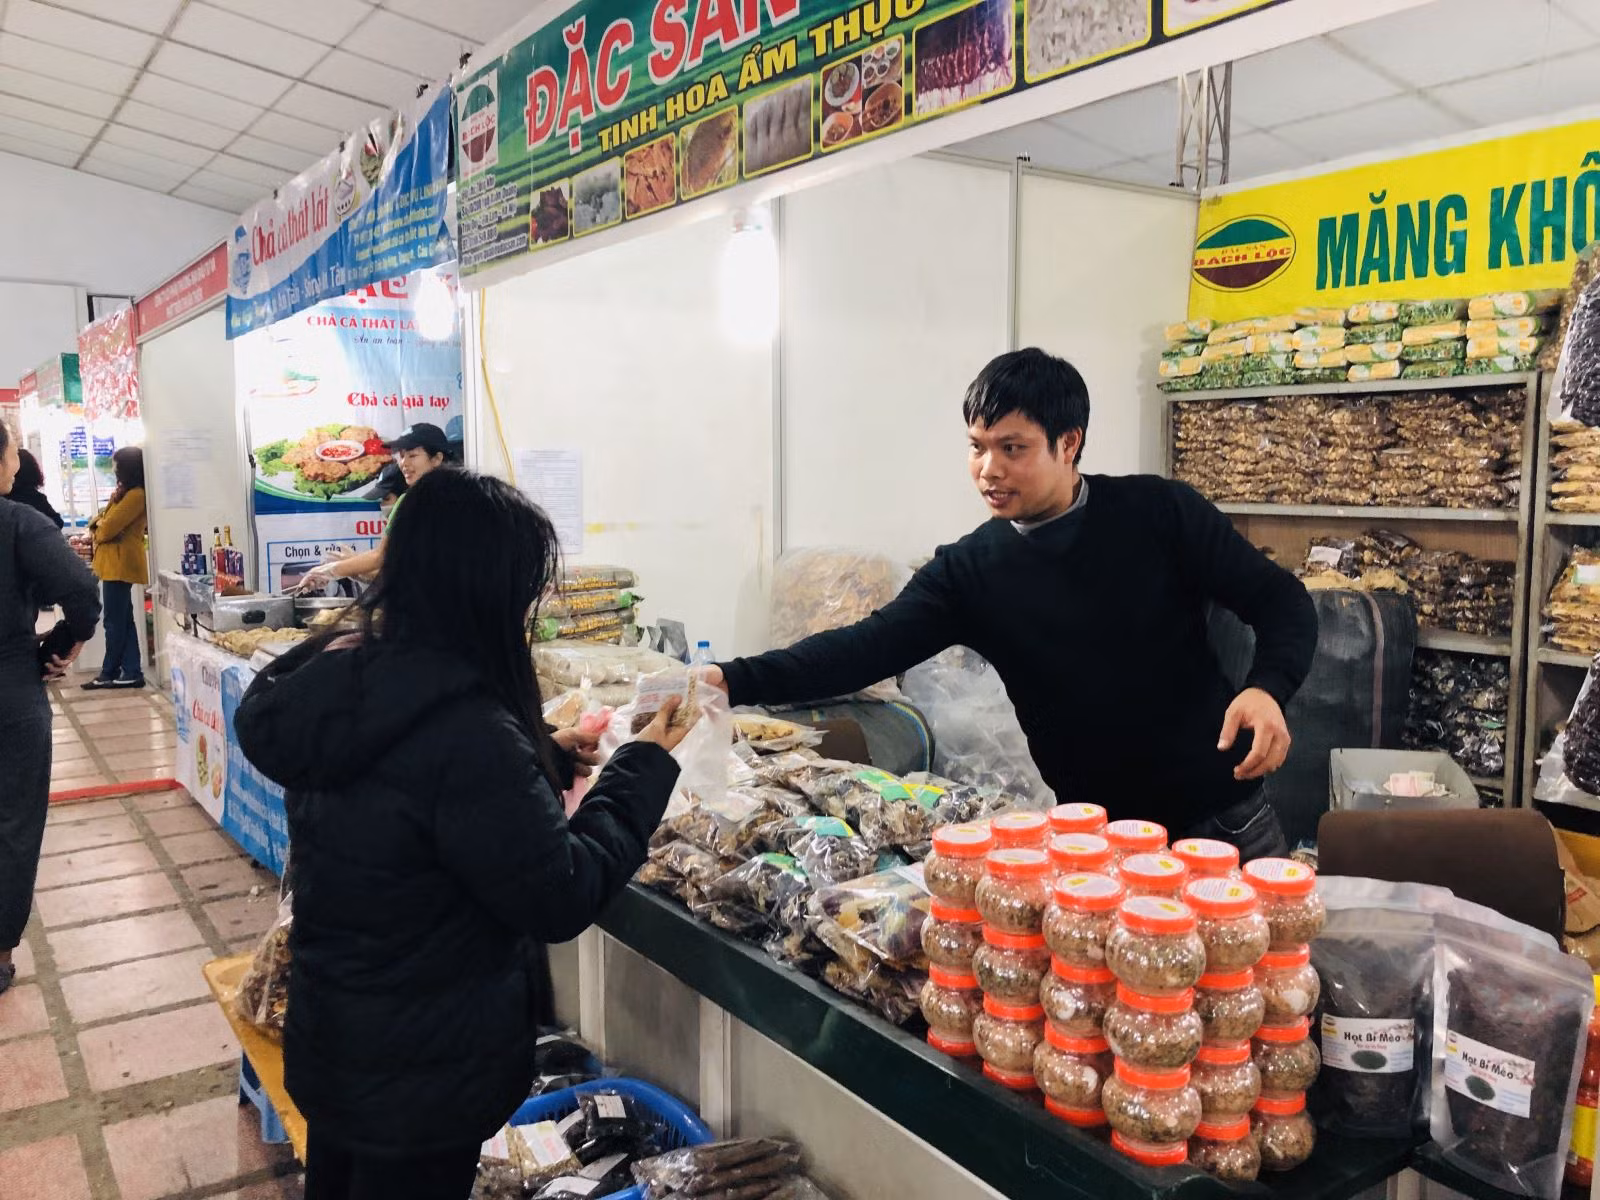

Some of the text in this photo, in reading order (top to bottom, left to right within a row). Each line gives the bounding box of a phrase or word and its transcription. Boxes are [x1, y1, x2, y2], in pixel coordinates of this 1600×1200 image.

[524, 15, 634, 154] ĐẶC
[599, 105, 657, 152] TINH
[665, 71, 730, 124] HOA
[1316, 189, 1468, 291] MĂNG
[307, 313, 337, 326] CHẢ
[340, 315, 357, 328] CÁ
[361, 316, 396, 329] THÁT
[347, 391, 378, 408] Chả
[383, 393, 398, 407] cá
[430, 394, 450, 411] tay
[285, 545, 310, 559] Chọn
[314, 544, 321, 556] &
[1344, 1031, 1362, 1045] Hạt
[1462, 1051, 1477, 1067] Hạt
